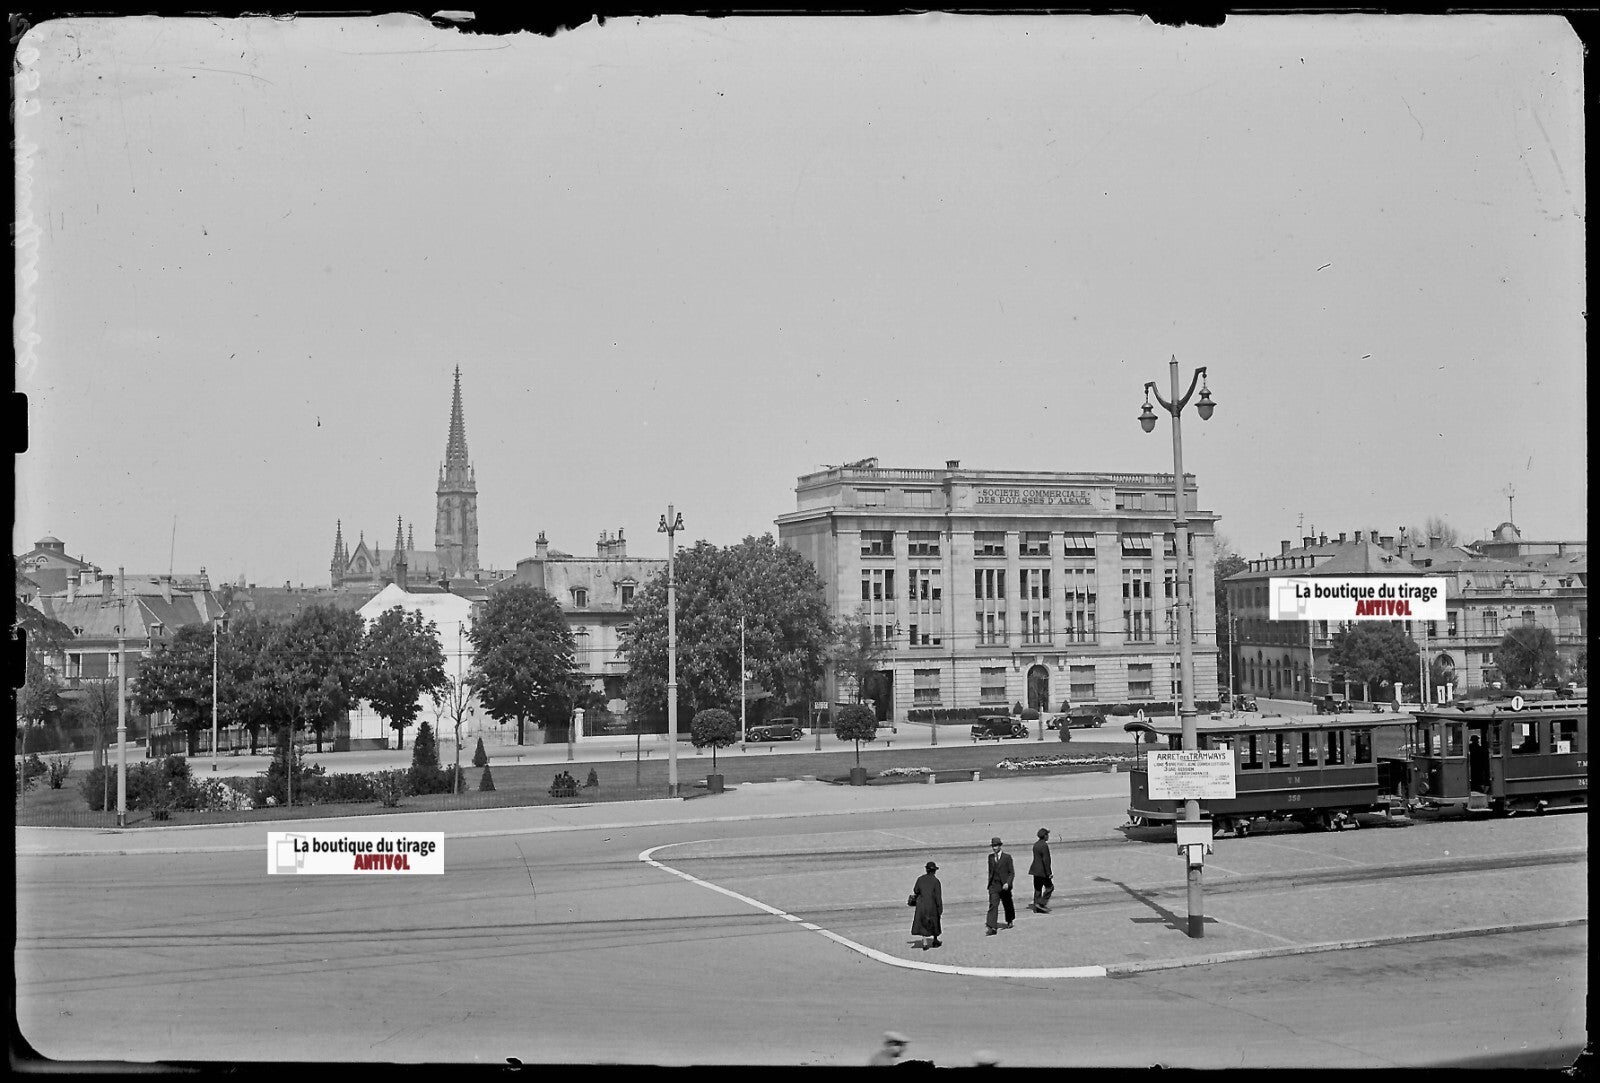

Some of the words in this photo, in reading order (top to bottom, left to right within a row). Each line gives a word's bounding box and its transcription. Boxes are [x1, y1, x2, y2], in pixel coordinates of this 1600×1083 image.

[982, 488, 1020, 497] SOCIETE
[1023, 489, 1086, 498] COMMERCIALE
[977, 496, 996, 504] DES
[999, 496, 1045, 504] POTASSES
[1189, 752, 1226, 760] TRAMWAYS
